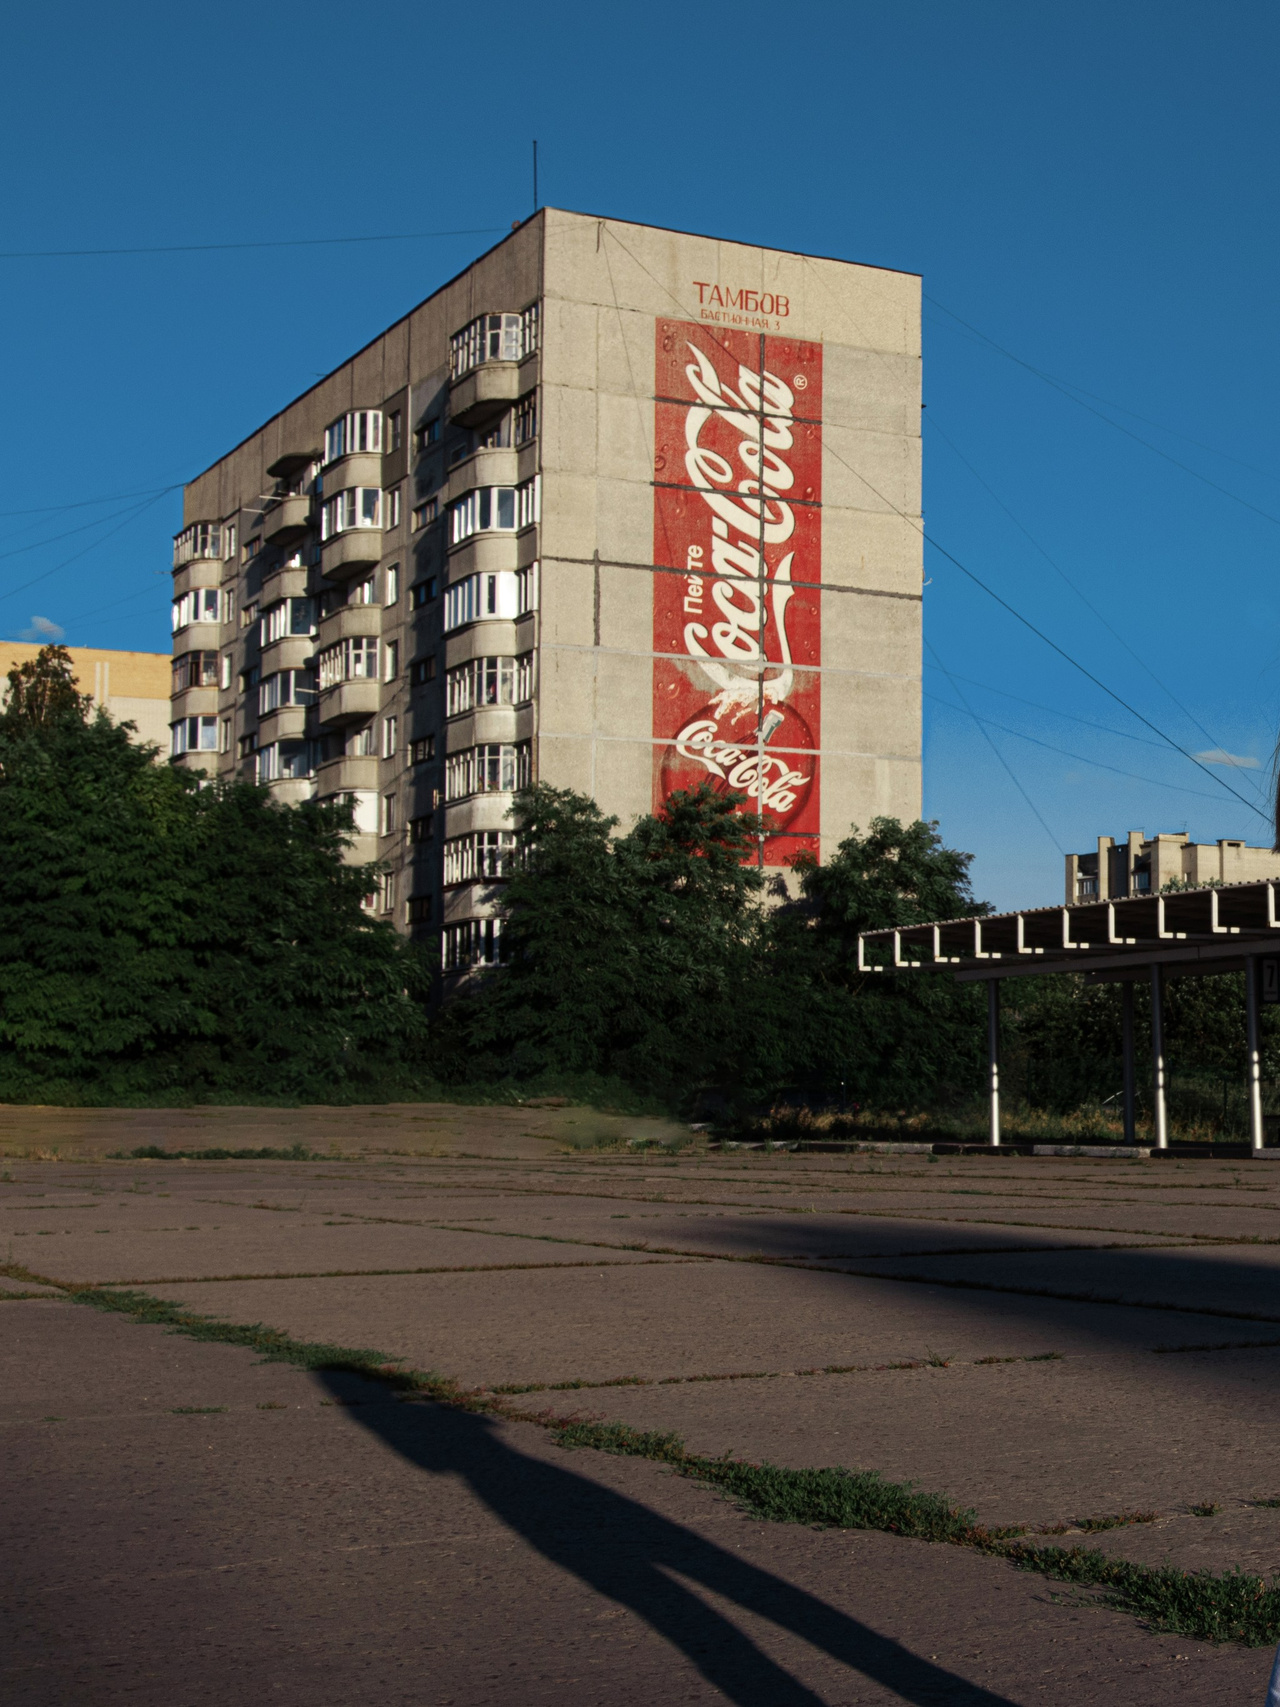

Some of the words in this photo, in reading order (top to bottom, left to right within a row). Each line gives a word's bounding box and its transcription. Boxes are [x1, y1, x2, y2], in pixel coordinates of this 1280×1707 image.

[692, 281, 790, 317] ТАМБОВ
[774, 320, 781, 331] 3
[684, 340, 795, 697] Coca-Cola
[676, 719, 811, 813] Coca-Cola
[1266, 965, 1275, 988] 7
